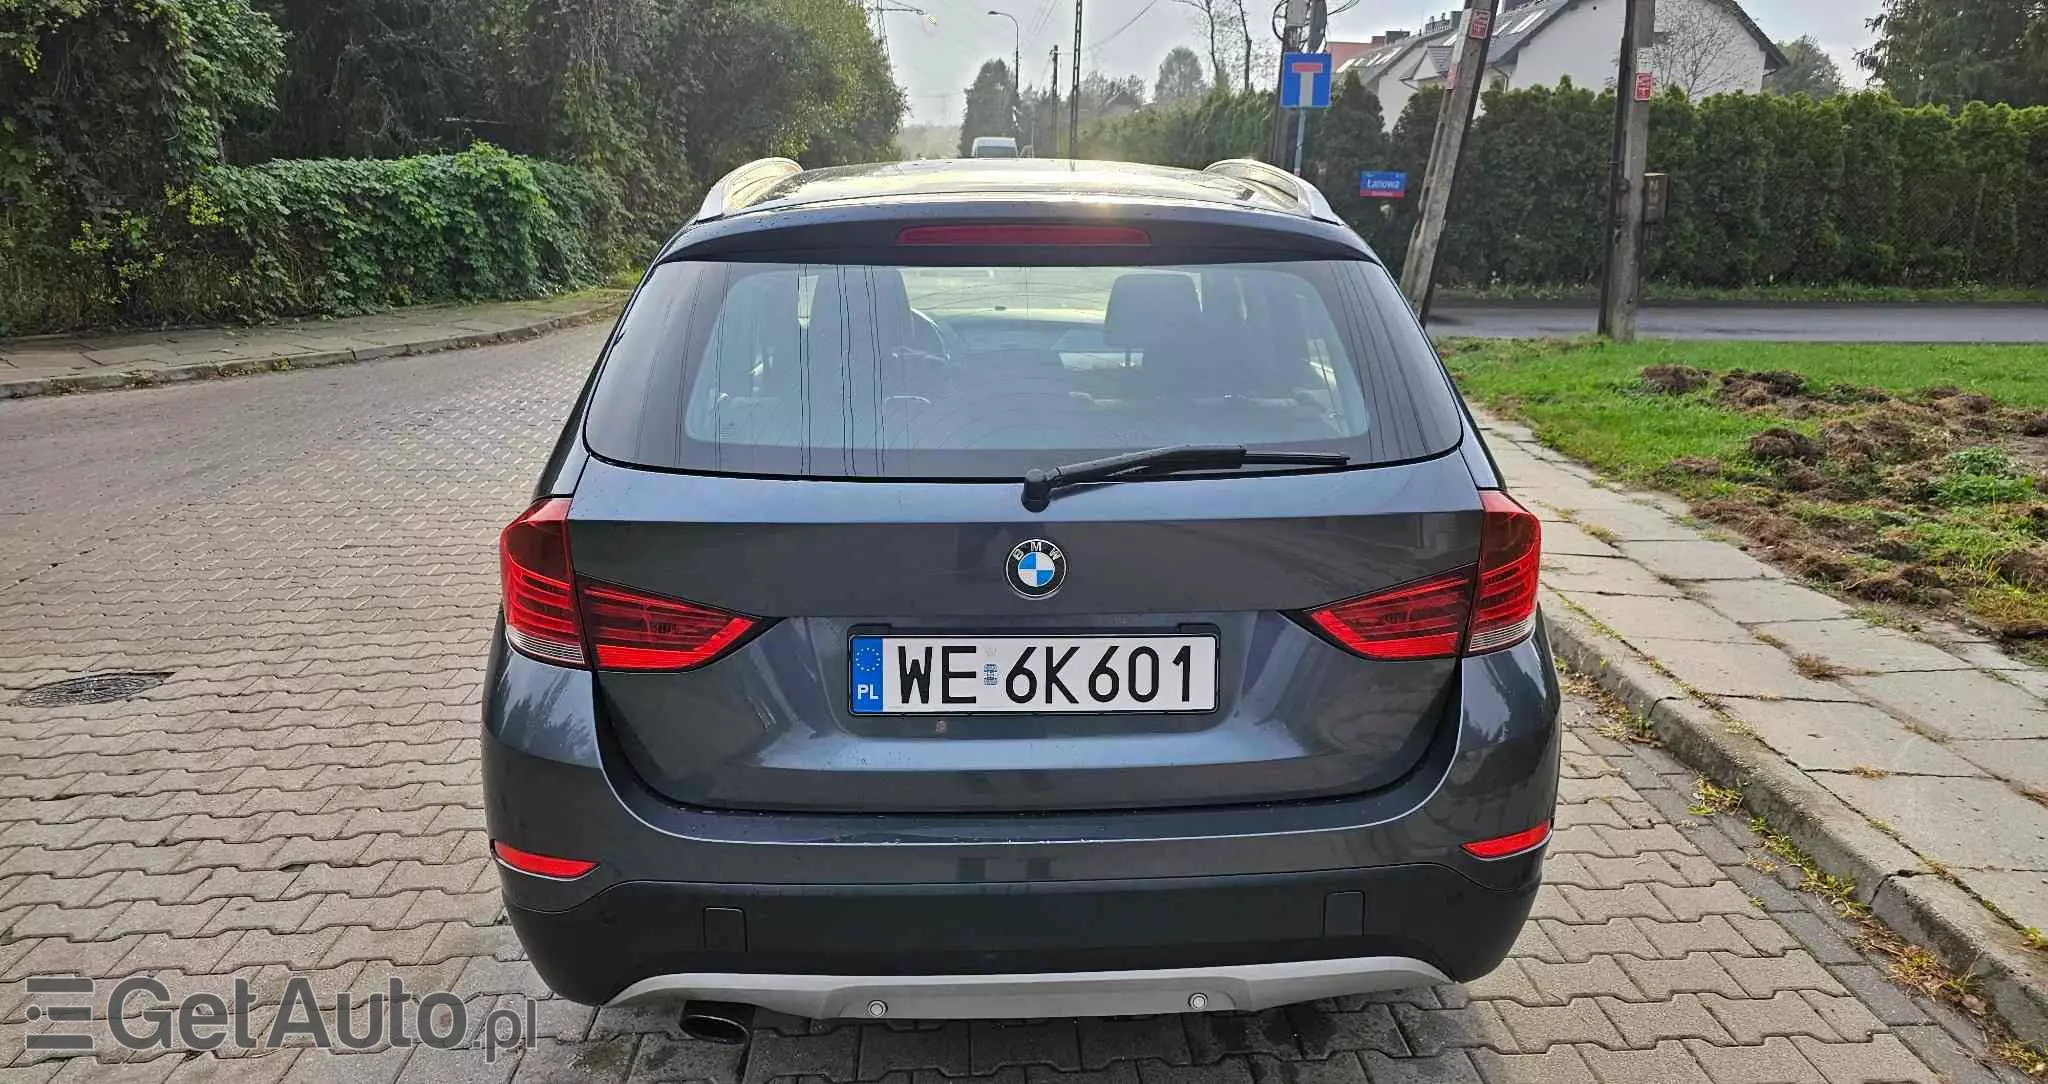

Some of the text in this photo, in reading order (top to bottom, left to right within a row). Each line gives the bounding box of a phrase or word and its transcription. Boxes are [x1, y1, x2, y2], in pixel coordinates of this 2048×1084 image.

[1013, 541, 1061, 561] BMW
[898, 645, 1192, 704] WE 6K601
[857, 684, 879, 700] PL
